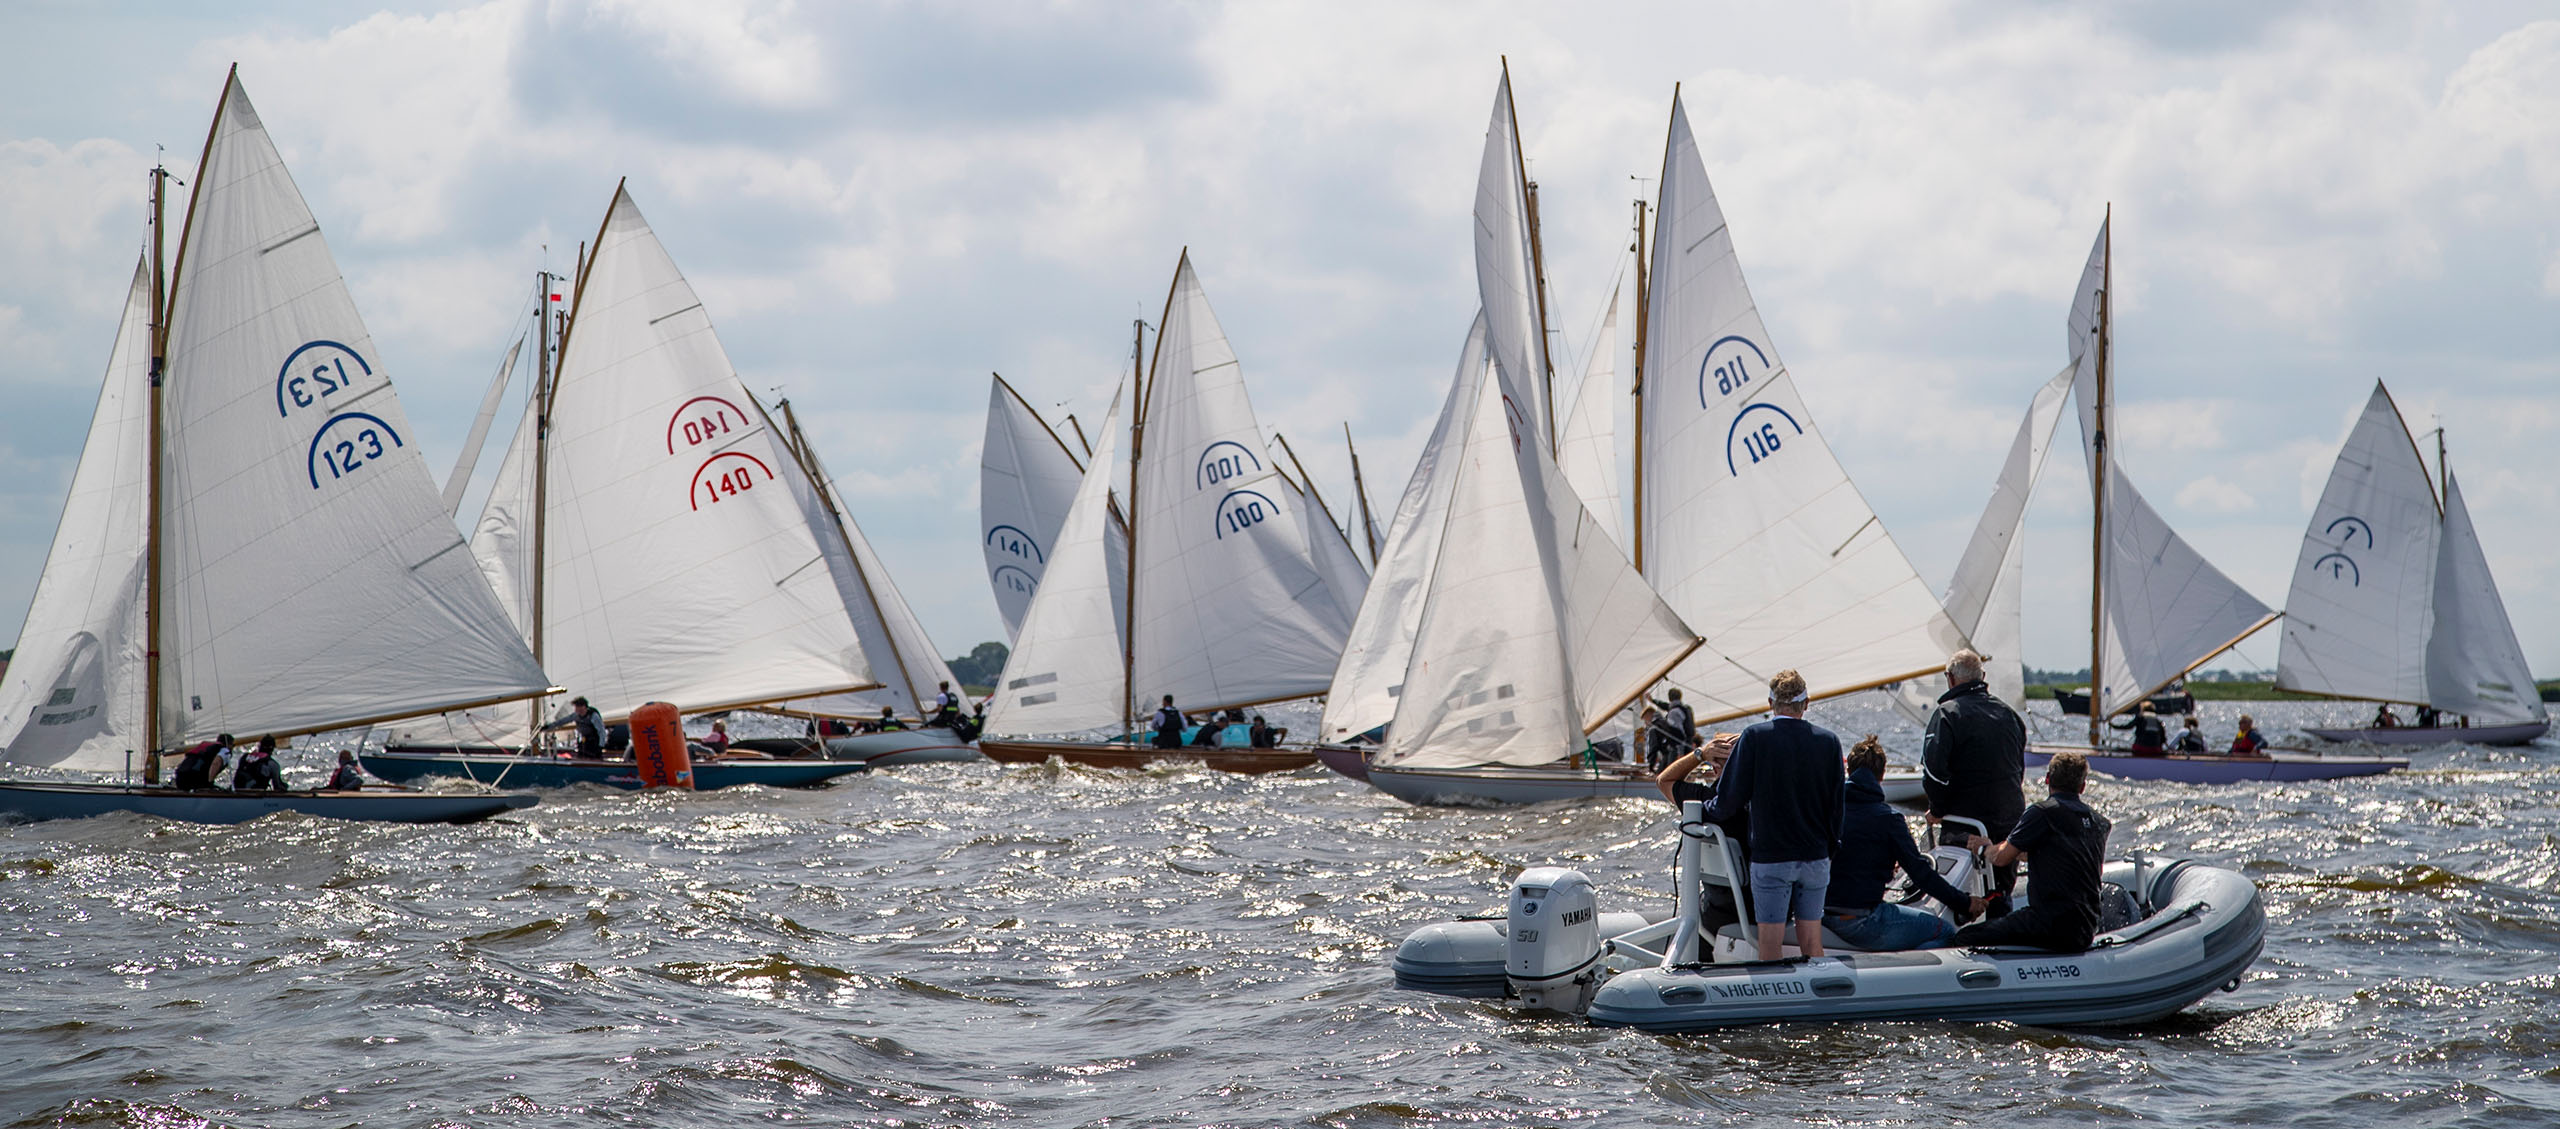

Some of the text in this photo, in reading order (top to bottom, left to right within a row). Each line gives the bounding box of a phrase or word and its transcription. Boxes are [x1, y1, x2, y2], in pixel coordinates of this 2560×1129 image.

[323, 428, 384, 479] 123
[1743, 422, 1782, 464] 116
[705, 467, 753, 503] 140
[1226, 501, 1264, 533] 100
[2347, 525, 2357, 541] 7
[1000, 535, 1028, 559] 141
[1561, 905, 1592, 928] YAMAHA
[1517, 929, 1539, 943] 50
[1726, 981, 1805, 998] HIGHFIELD
